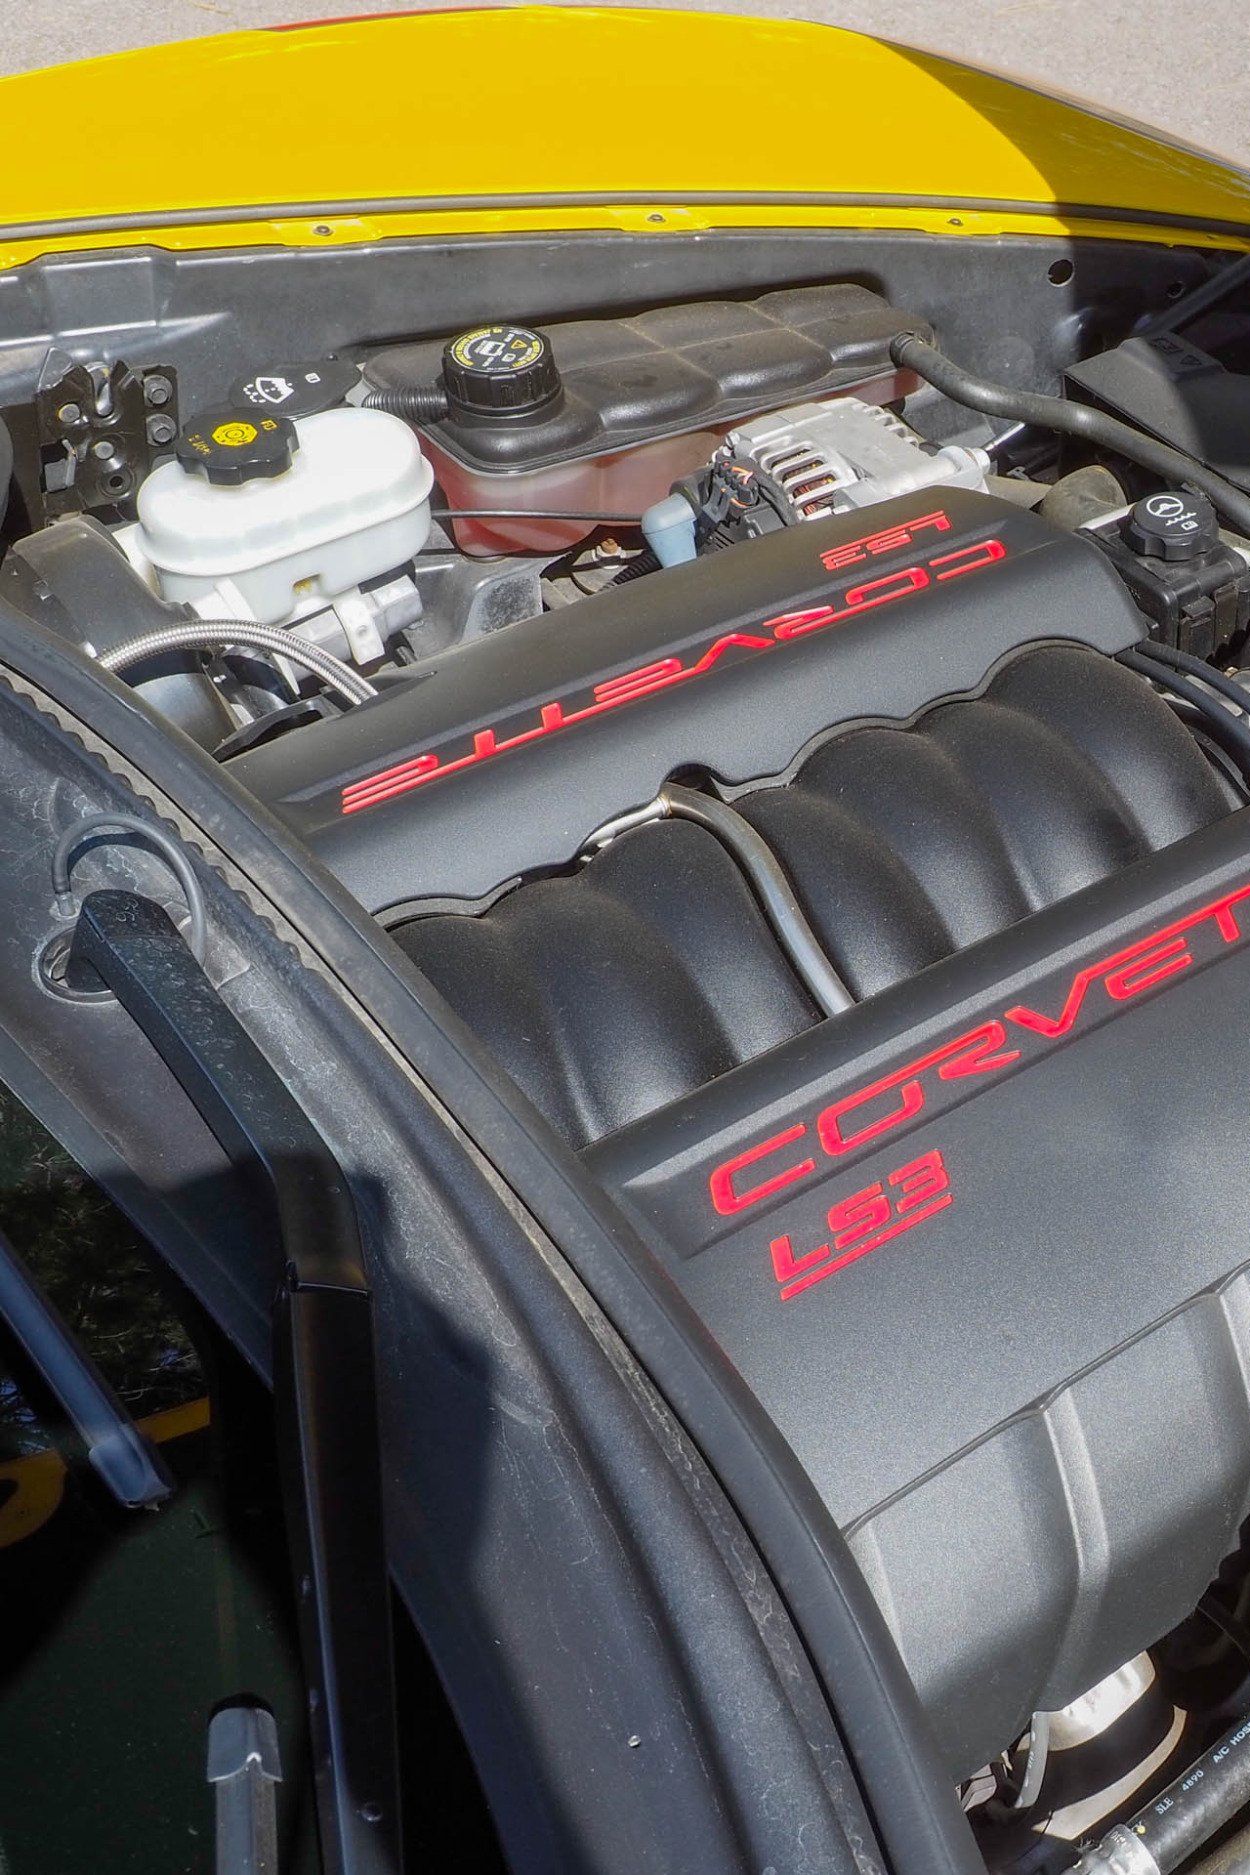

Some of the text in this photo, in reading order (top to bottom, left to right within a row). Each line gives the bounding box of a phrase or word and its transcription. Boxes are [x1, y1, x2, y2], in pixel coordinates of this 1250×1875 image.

[821, 512, 951, 570] LS3
[342, 540, 1006, 813] CORVETTE
[770, 1150, 951, 1286] LS3
[1212, 1746, 1230, 1763] A/C
